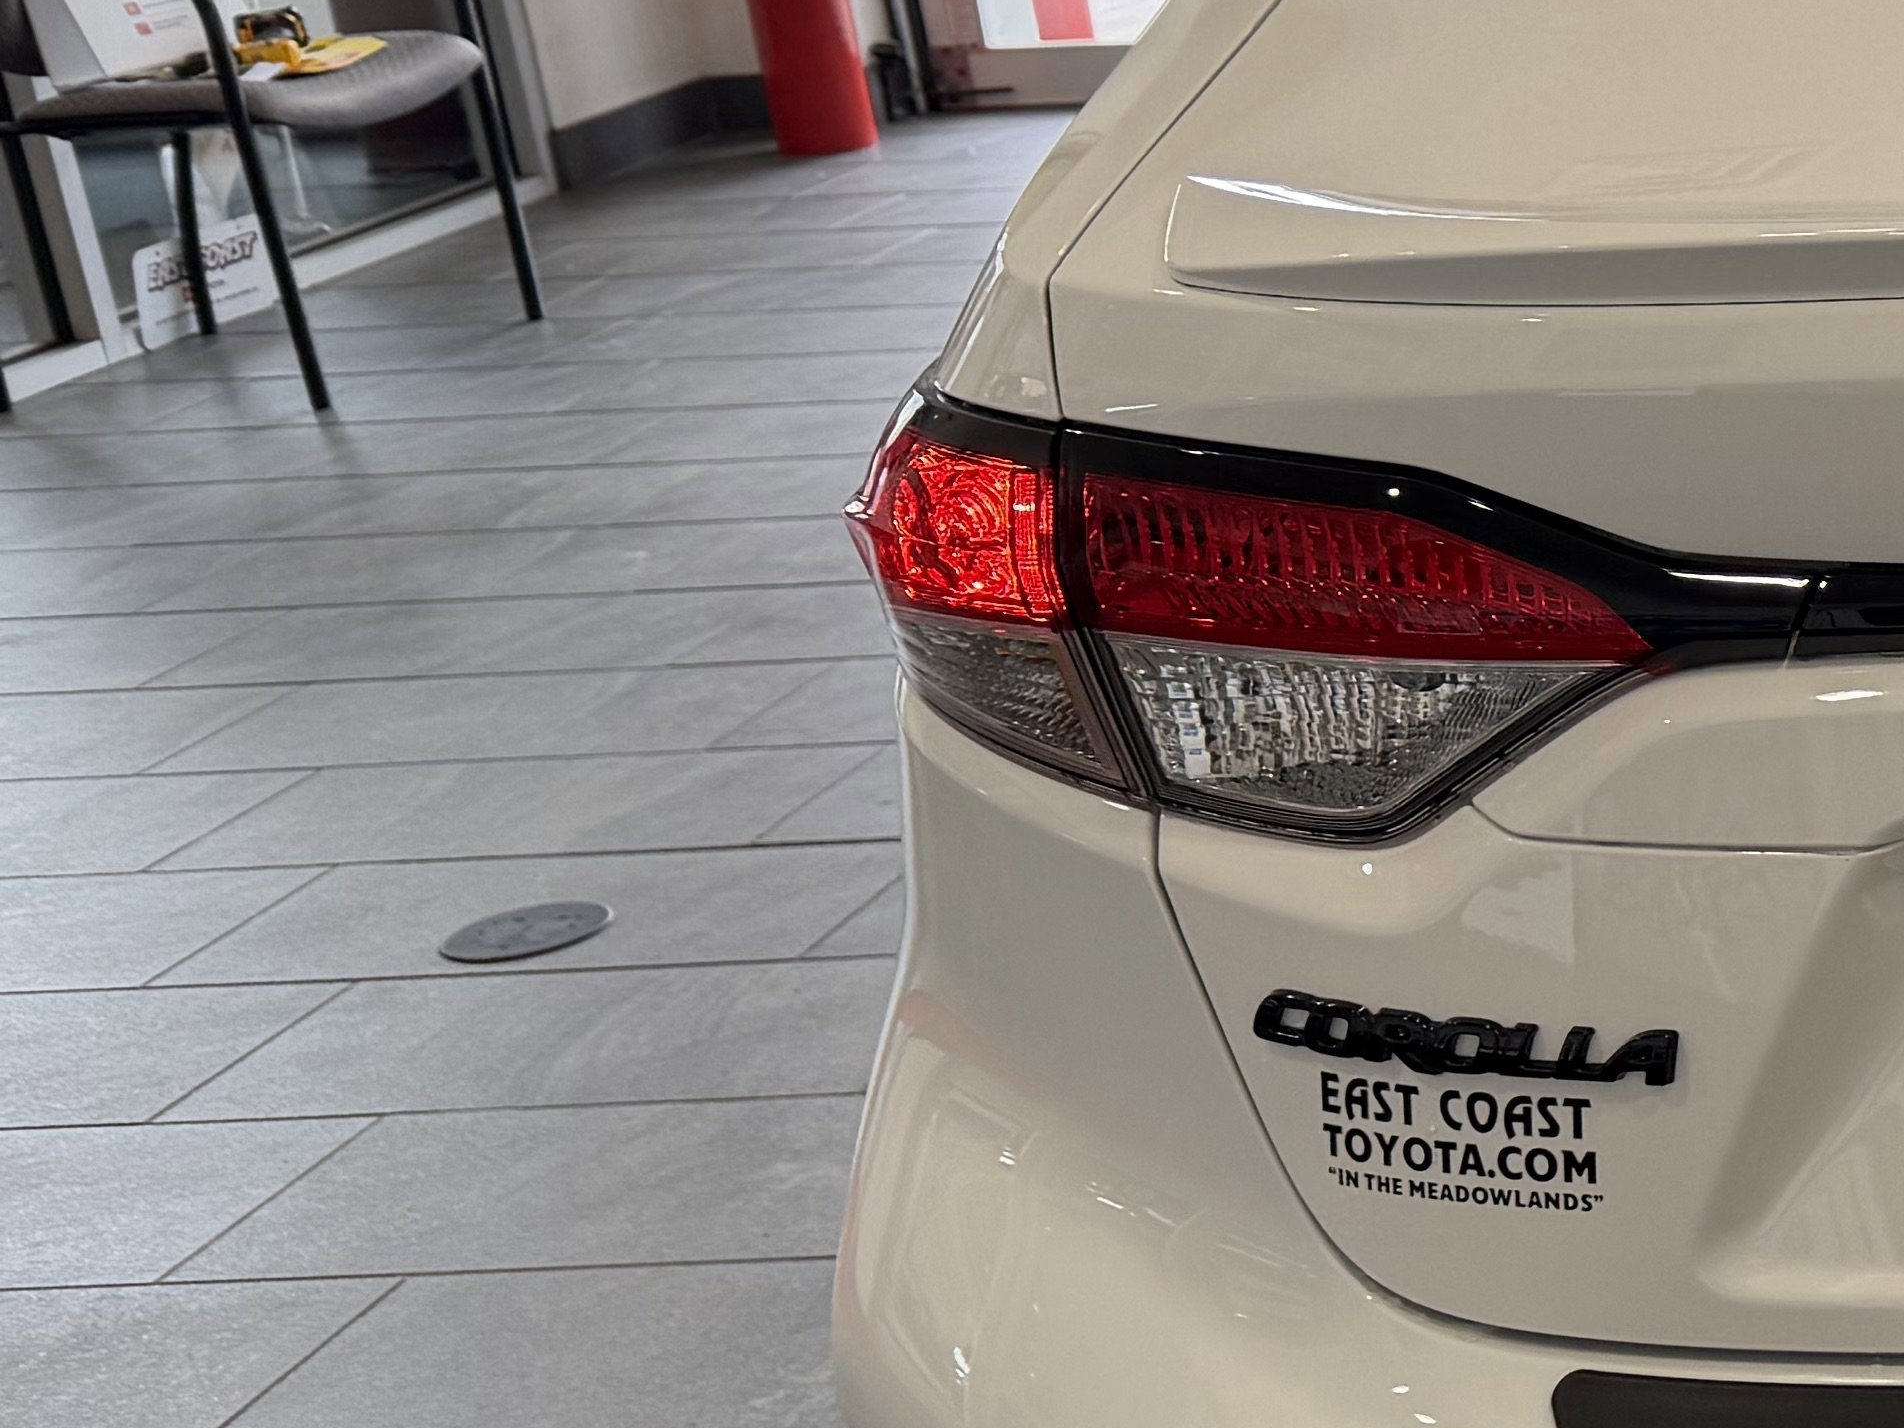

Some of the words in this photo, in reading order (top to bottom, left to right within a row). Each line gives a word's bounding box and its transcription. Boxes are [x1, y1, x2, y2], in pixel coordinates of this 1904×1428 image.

[1253, 988, 1679, 1087] COROLLA
[1320, 1070, 1420, 1126] EAST
[1439, 1089, 1591, 1140] COAST
[1323, 1123, 1597, 1185] TOYOTA.COM
[1364, 1172, 1403, 1196] THE
